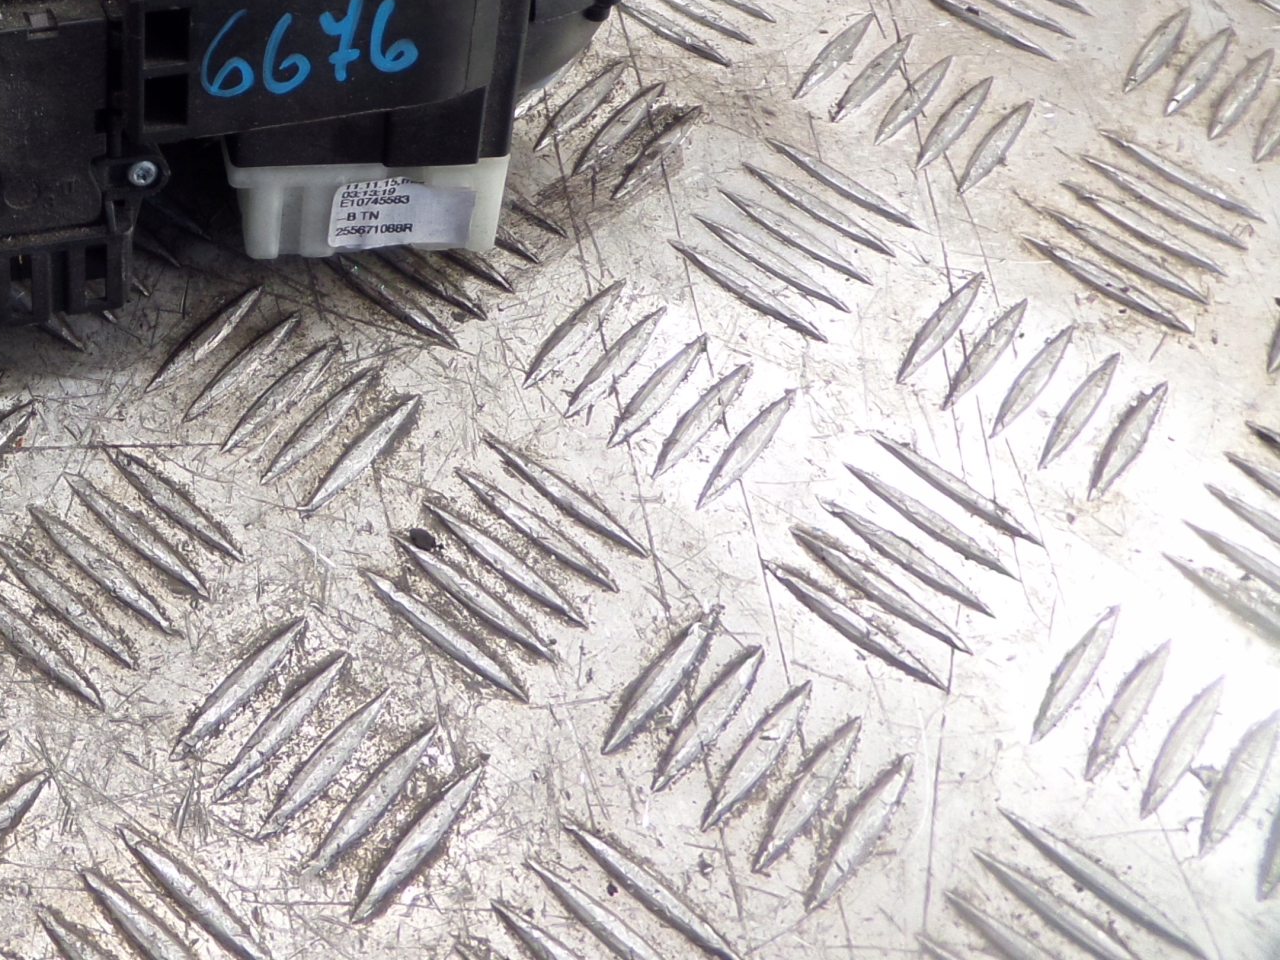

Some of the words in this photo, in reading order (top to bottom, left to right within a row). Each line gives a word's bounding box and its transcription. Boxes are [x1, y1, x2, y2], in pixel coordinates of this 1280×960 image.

[341, 187, 396, 199] 03:13:19
[339, 194, 410, 208] E10745583
[360, 210, 380, 221] TN
